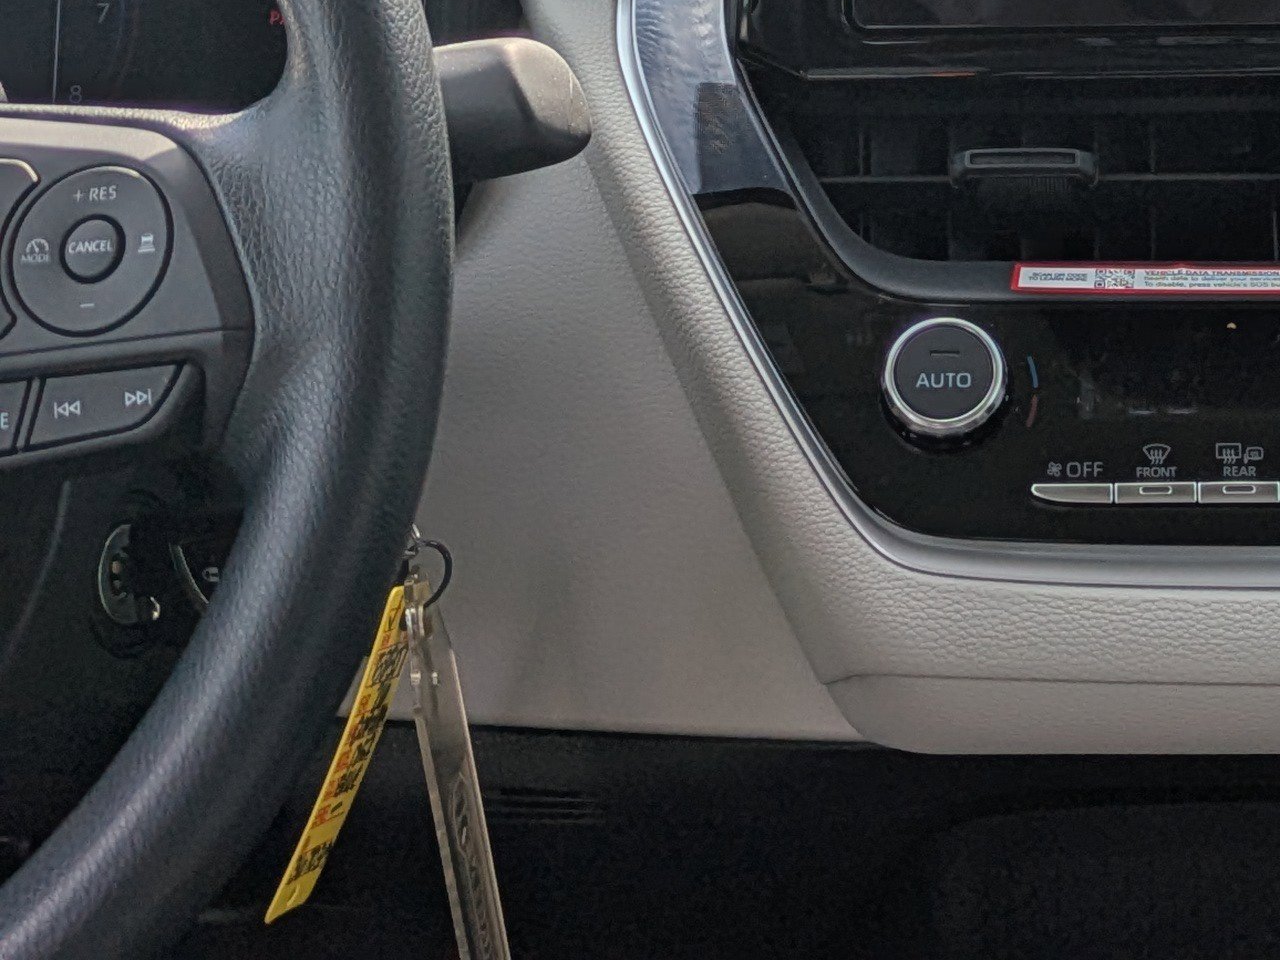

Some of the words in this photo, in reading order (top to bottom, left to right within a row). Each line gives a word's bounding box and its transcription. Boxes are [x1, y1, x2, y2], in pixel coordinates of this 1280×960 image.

[96, 3, 109, 23] 7
[68, 239, 115, 254] CANCEL
[916, 372, 972, 389] AUTO
[1066, 462, 1103, 478] OFF
[1136, 466, 1177, 479] FRONT
[1223, 465, 1256, 477] REAR
